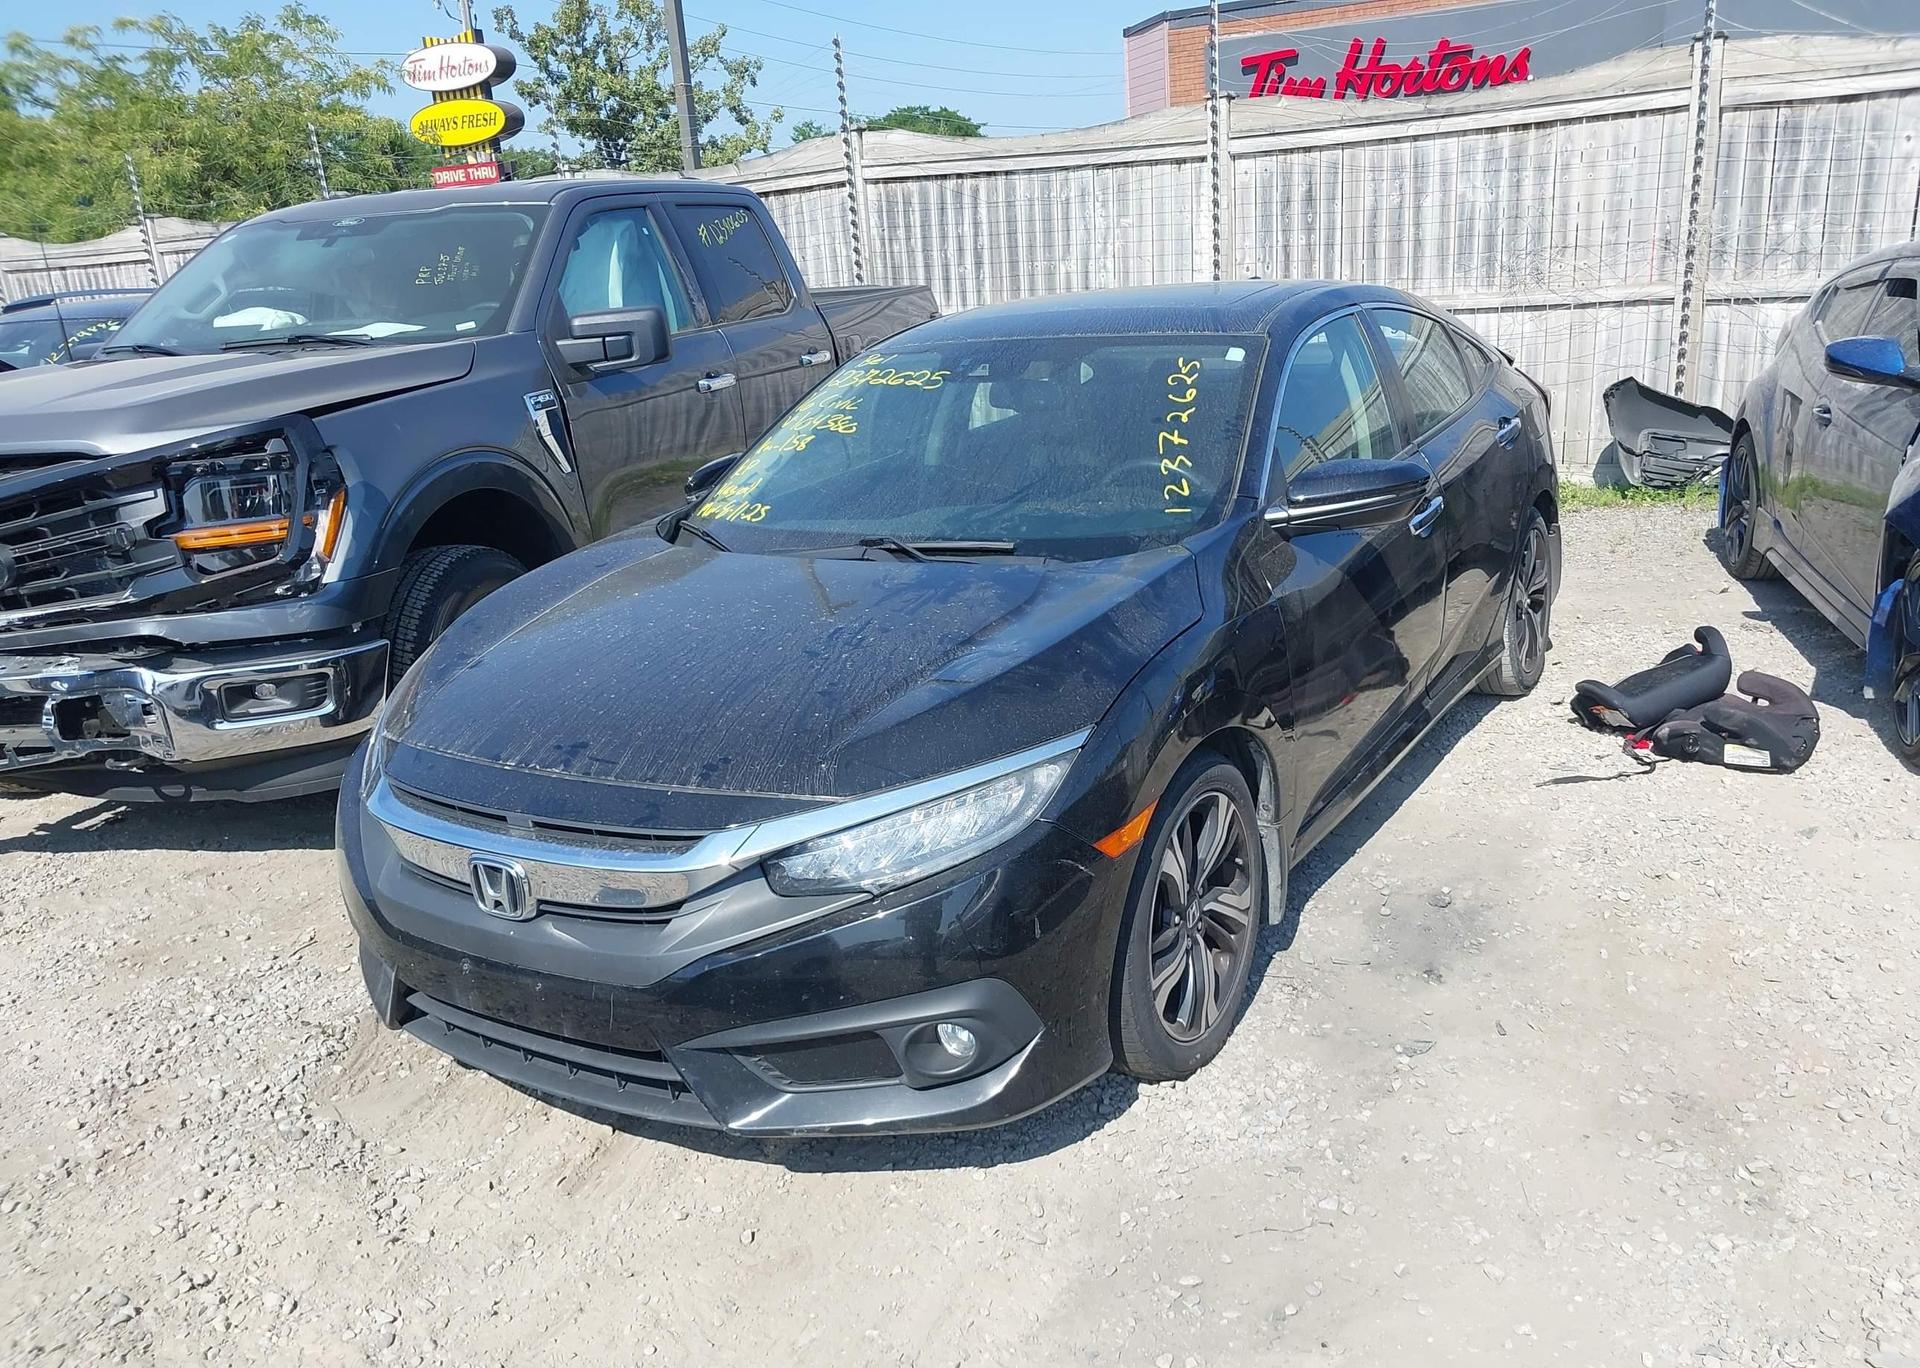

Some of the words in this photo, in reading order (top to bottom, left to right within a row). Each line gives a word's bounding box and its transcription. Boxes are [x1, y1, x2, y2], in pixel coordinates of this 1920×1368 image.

[408, 58, 437, 84] Tim
[439, 54, 490, 79] Hortons
[1240, 47, 1327, 99] Tim
[1333, 36, 1532, 101] Hortons
[418, 115, 459, 133] ALWAYS
[461, 111, 498, 130] FRESH
[435, 169, 467, 185] DRIVE
[467, 165, 497, 180] THRU
[1158, 356, 1201, 513] 12372625
